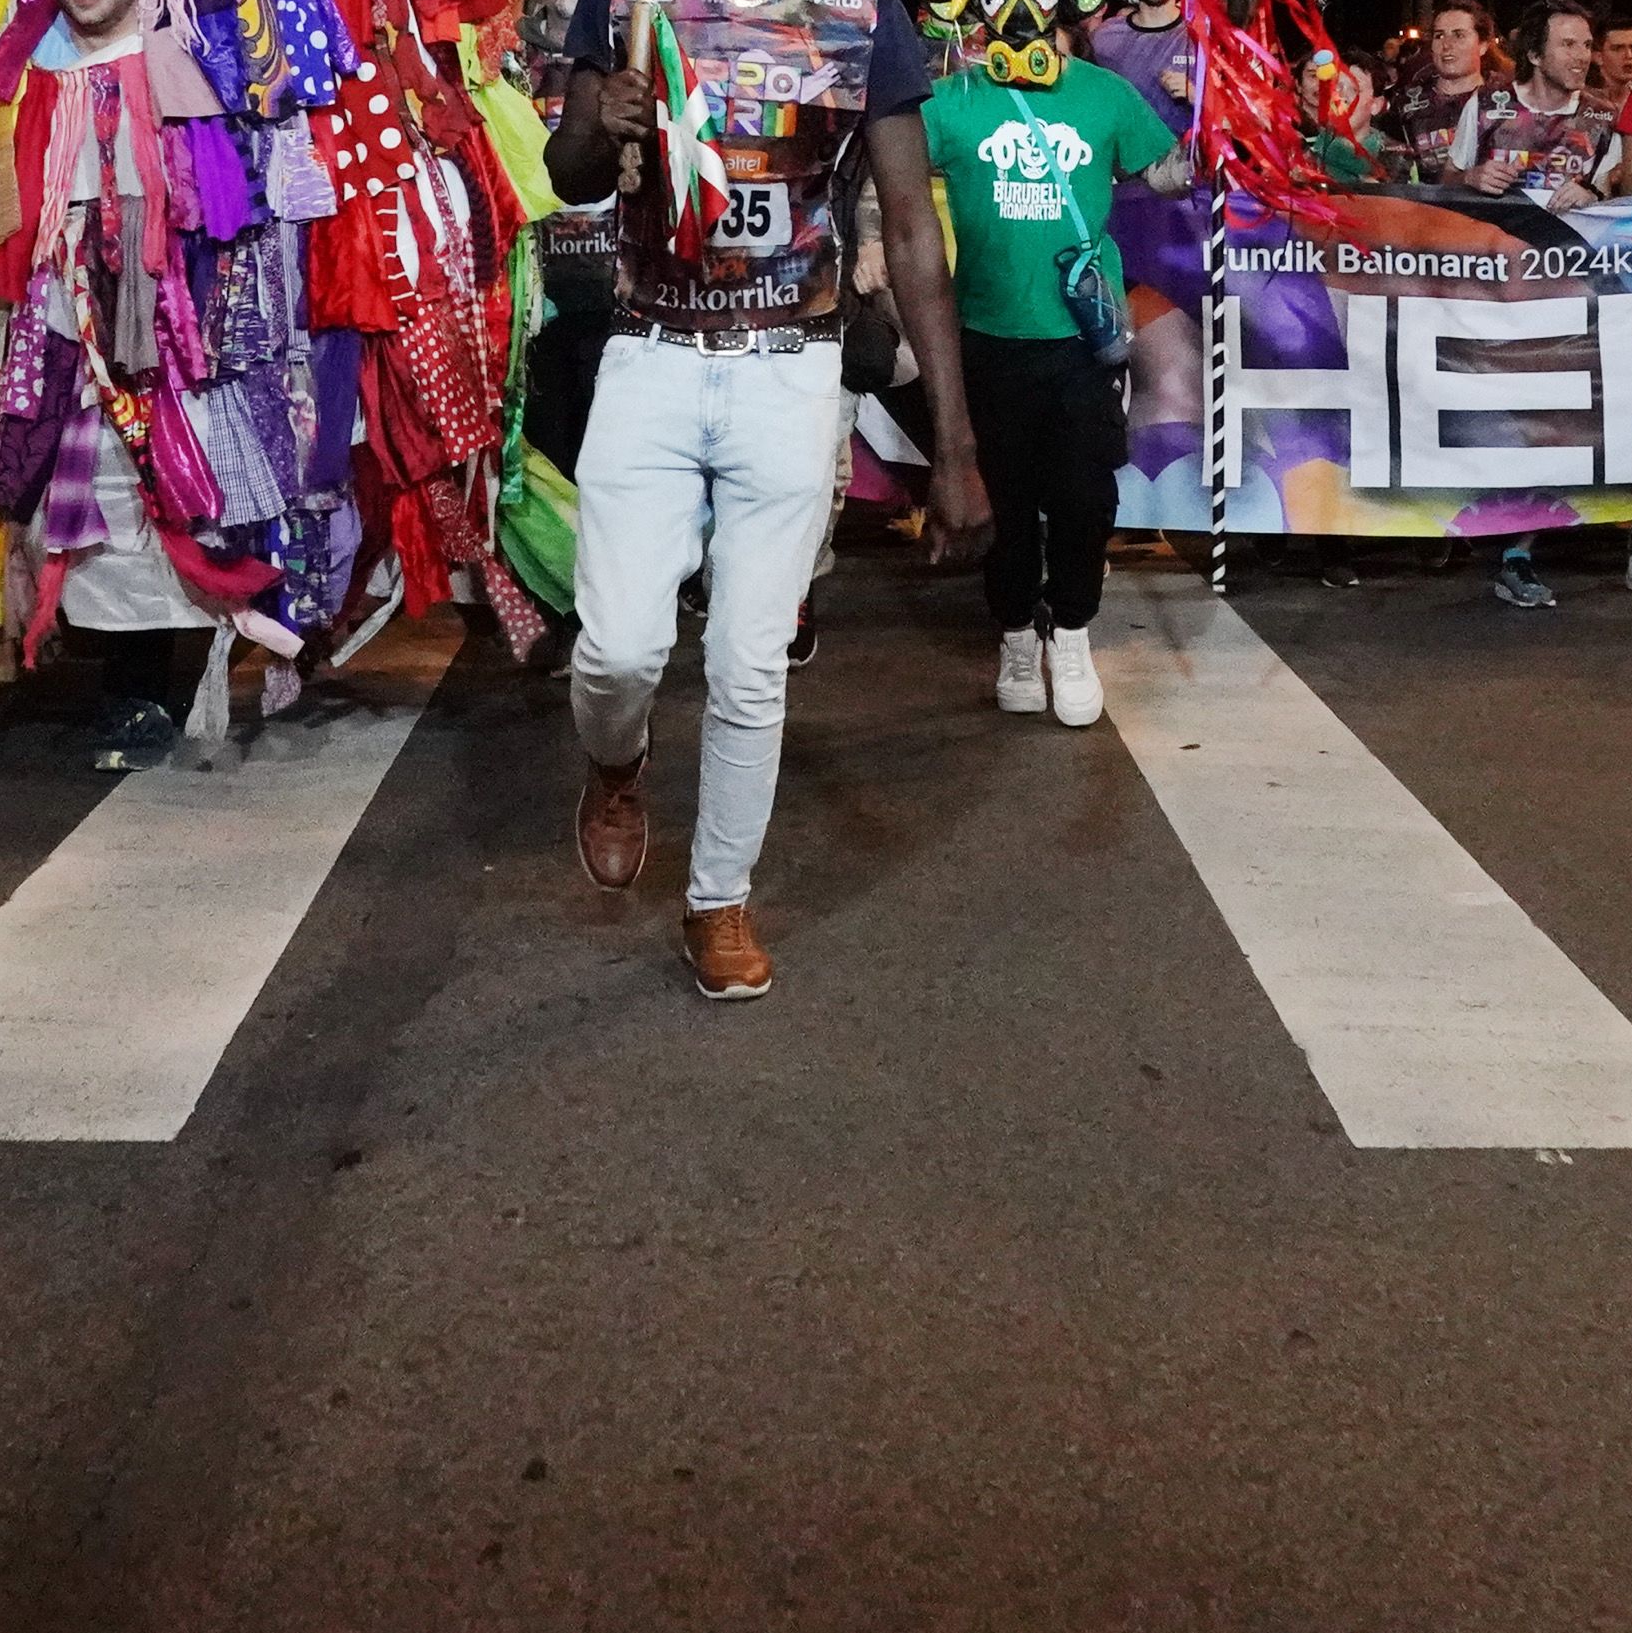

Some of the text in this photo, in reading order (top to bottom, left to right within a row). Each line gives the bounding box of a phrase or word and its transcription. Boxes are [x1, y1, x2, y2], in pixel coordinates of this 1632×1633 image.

[727, 155, 761, 172] altel
[709, 190, 771, 238] 35
[1202, 240, 1327, 274] Iundik
[1338, 243, 1510, 283] Baionarat
